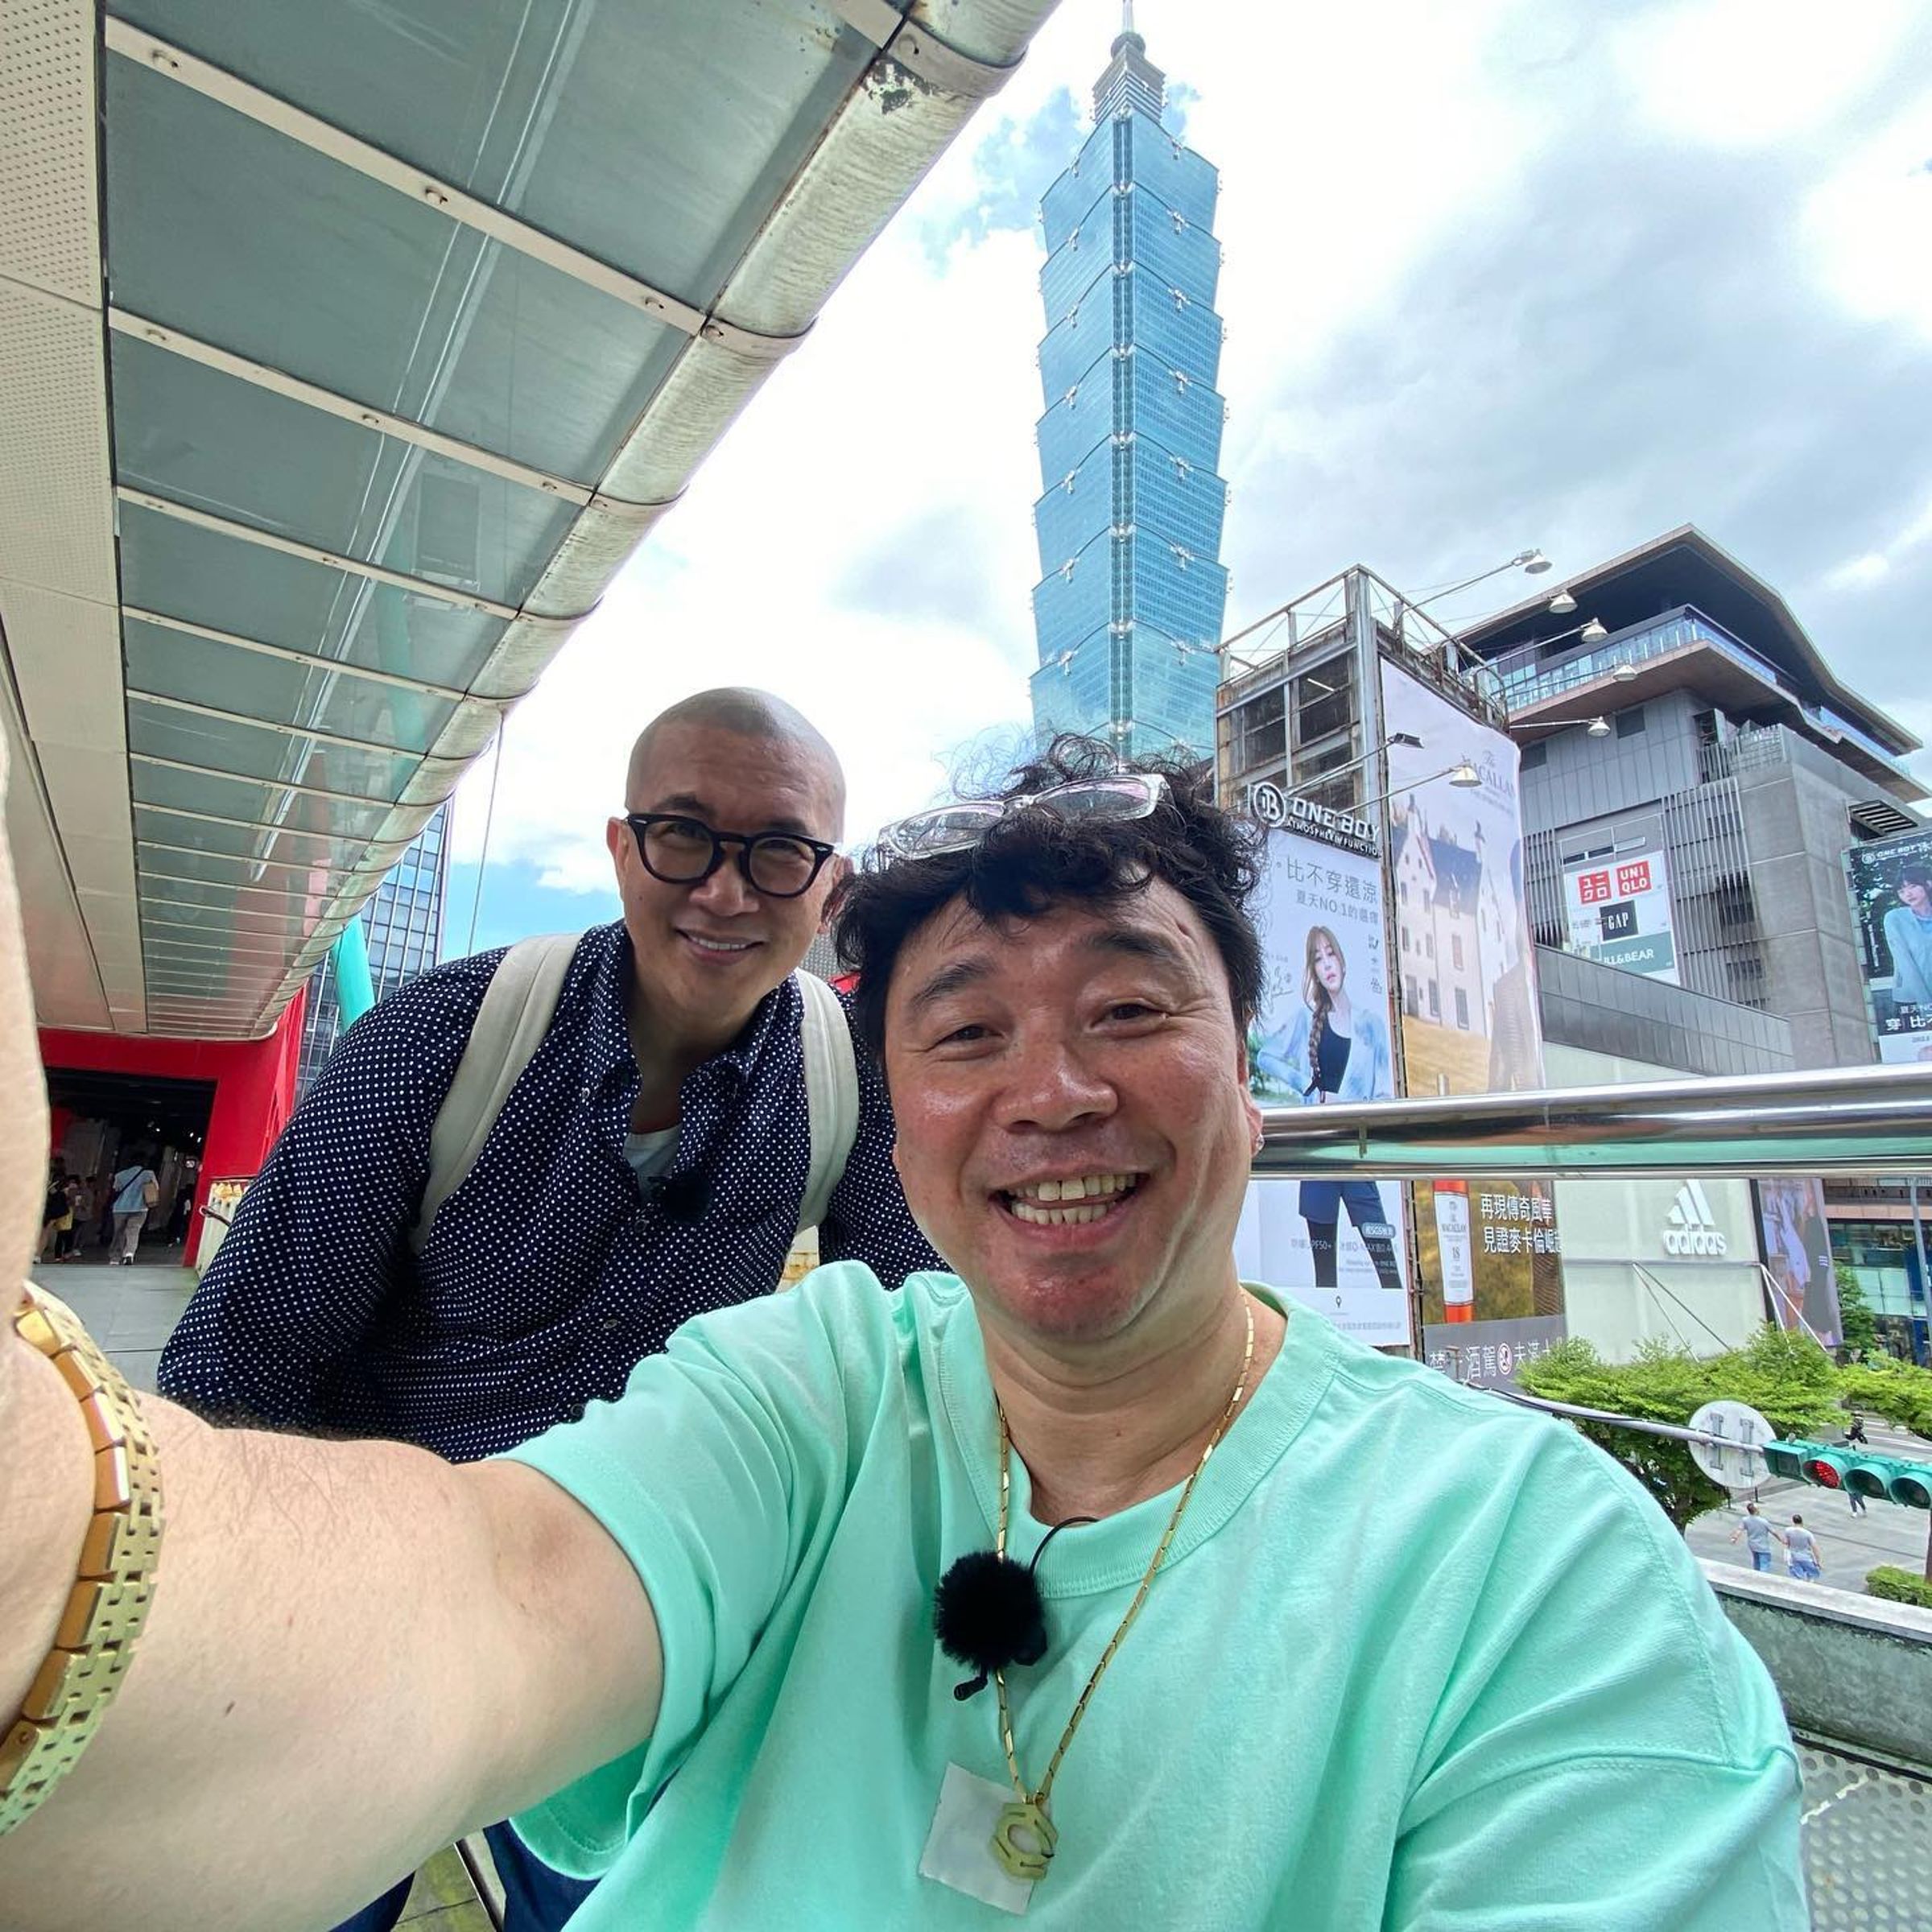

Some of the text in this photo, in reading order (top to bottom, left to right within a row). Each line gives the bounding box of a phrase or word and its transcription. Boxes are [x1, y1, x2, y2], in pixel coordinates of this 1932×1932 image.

[1293, 797, 1380, 842] ONE BOY
[1620, 865, 1644, 880] UNI
[1621, 877, 1647, 893] QLO
[1608, 911, 1629, 930] GAP
[1663, 1224, 1727, 1255] adidas
